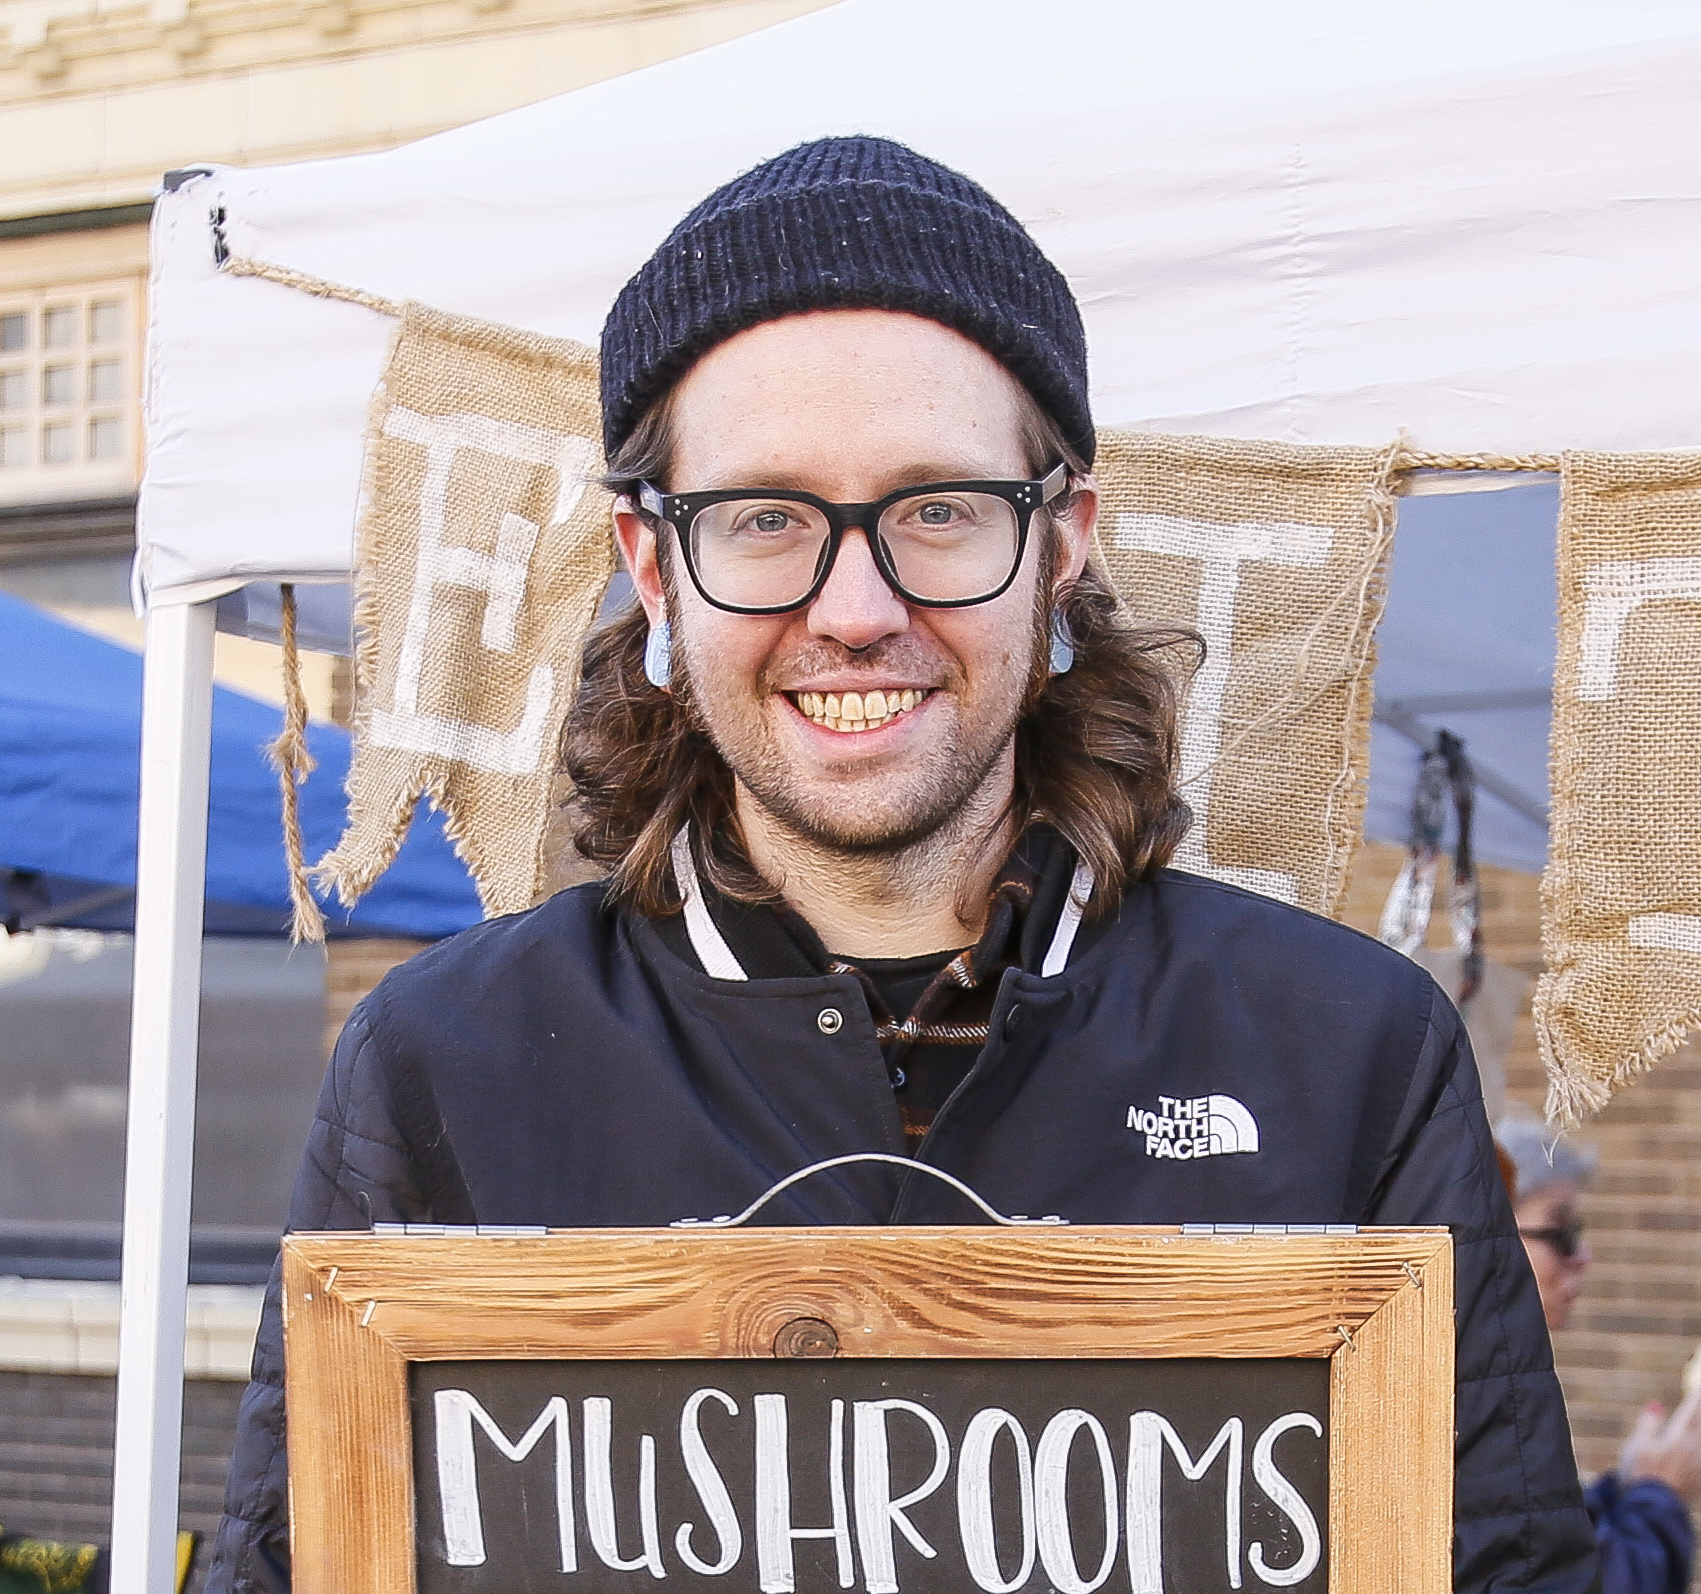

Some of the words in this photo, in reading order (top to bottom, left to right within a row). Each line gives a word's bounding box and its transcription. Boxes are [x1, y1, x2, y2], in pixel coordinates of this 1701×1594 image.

[1157, 1094, 1209, 1119] THE
[1126, 1105, 1209, 1138] NORTH
[1145, 1133, 1210, 1161] FACE
